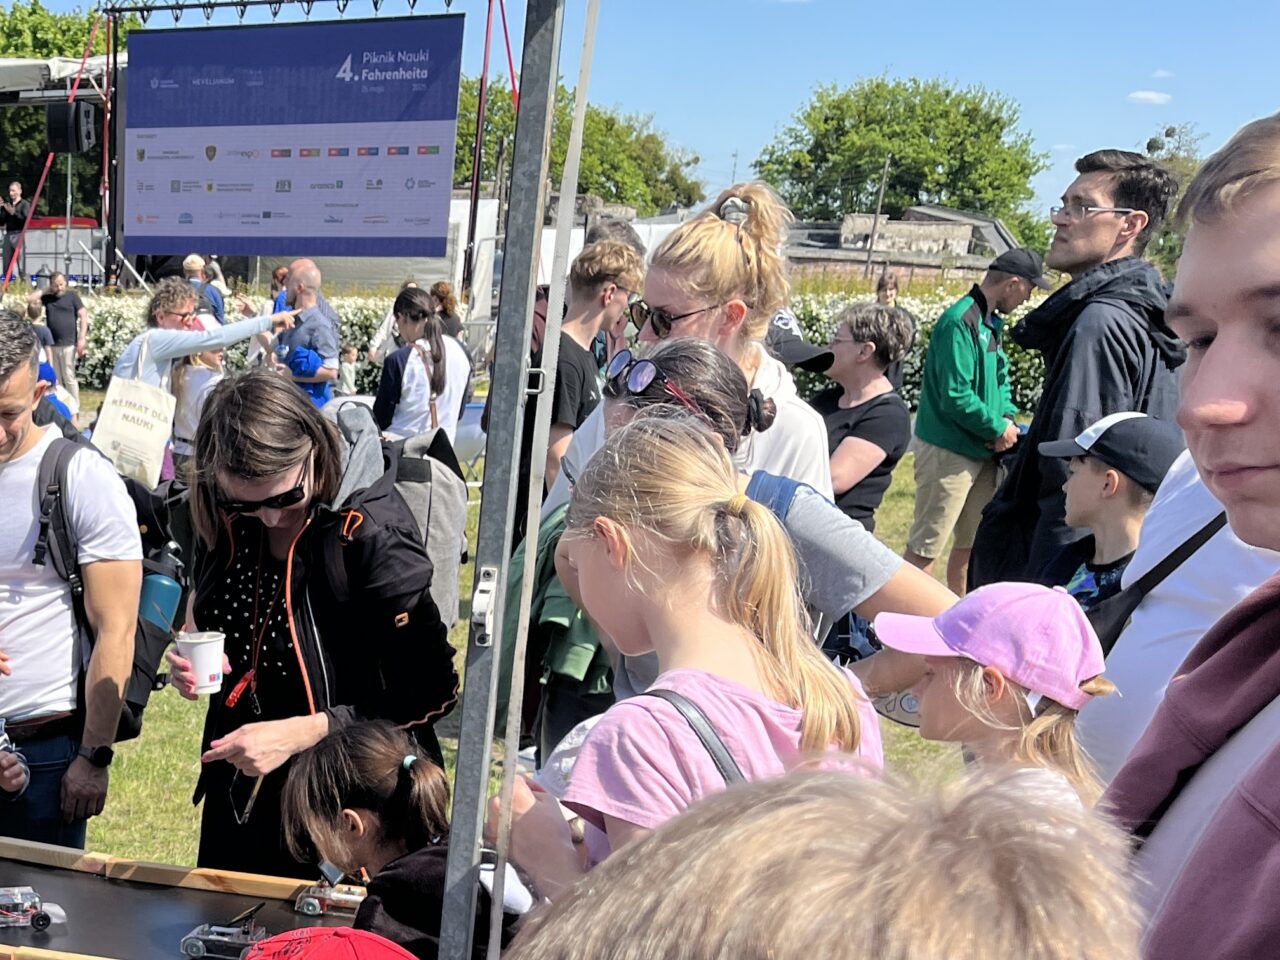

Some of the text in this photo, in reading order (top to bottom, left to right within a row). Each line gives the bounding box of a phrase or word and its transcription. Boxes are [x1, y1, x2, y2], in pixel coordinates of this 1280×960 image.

[362, 49, 429, 64] Piknik Nauki
[361, 67, 428, 80] Fahrenheita
[111, 398, 170, 424] KLIMAT DLA
[121, 413, 155, 431] NAUKI
